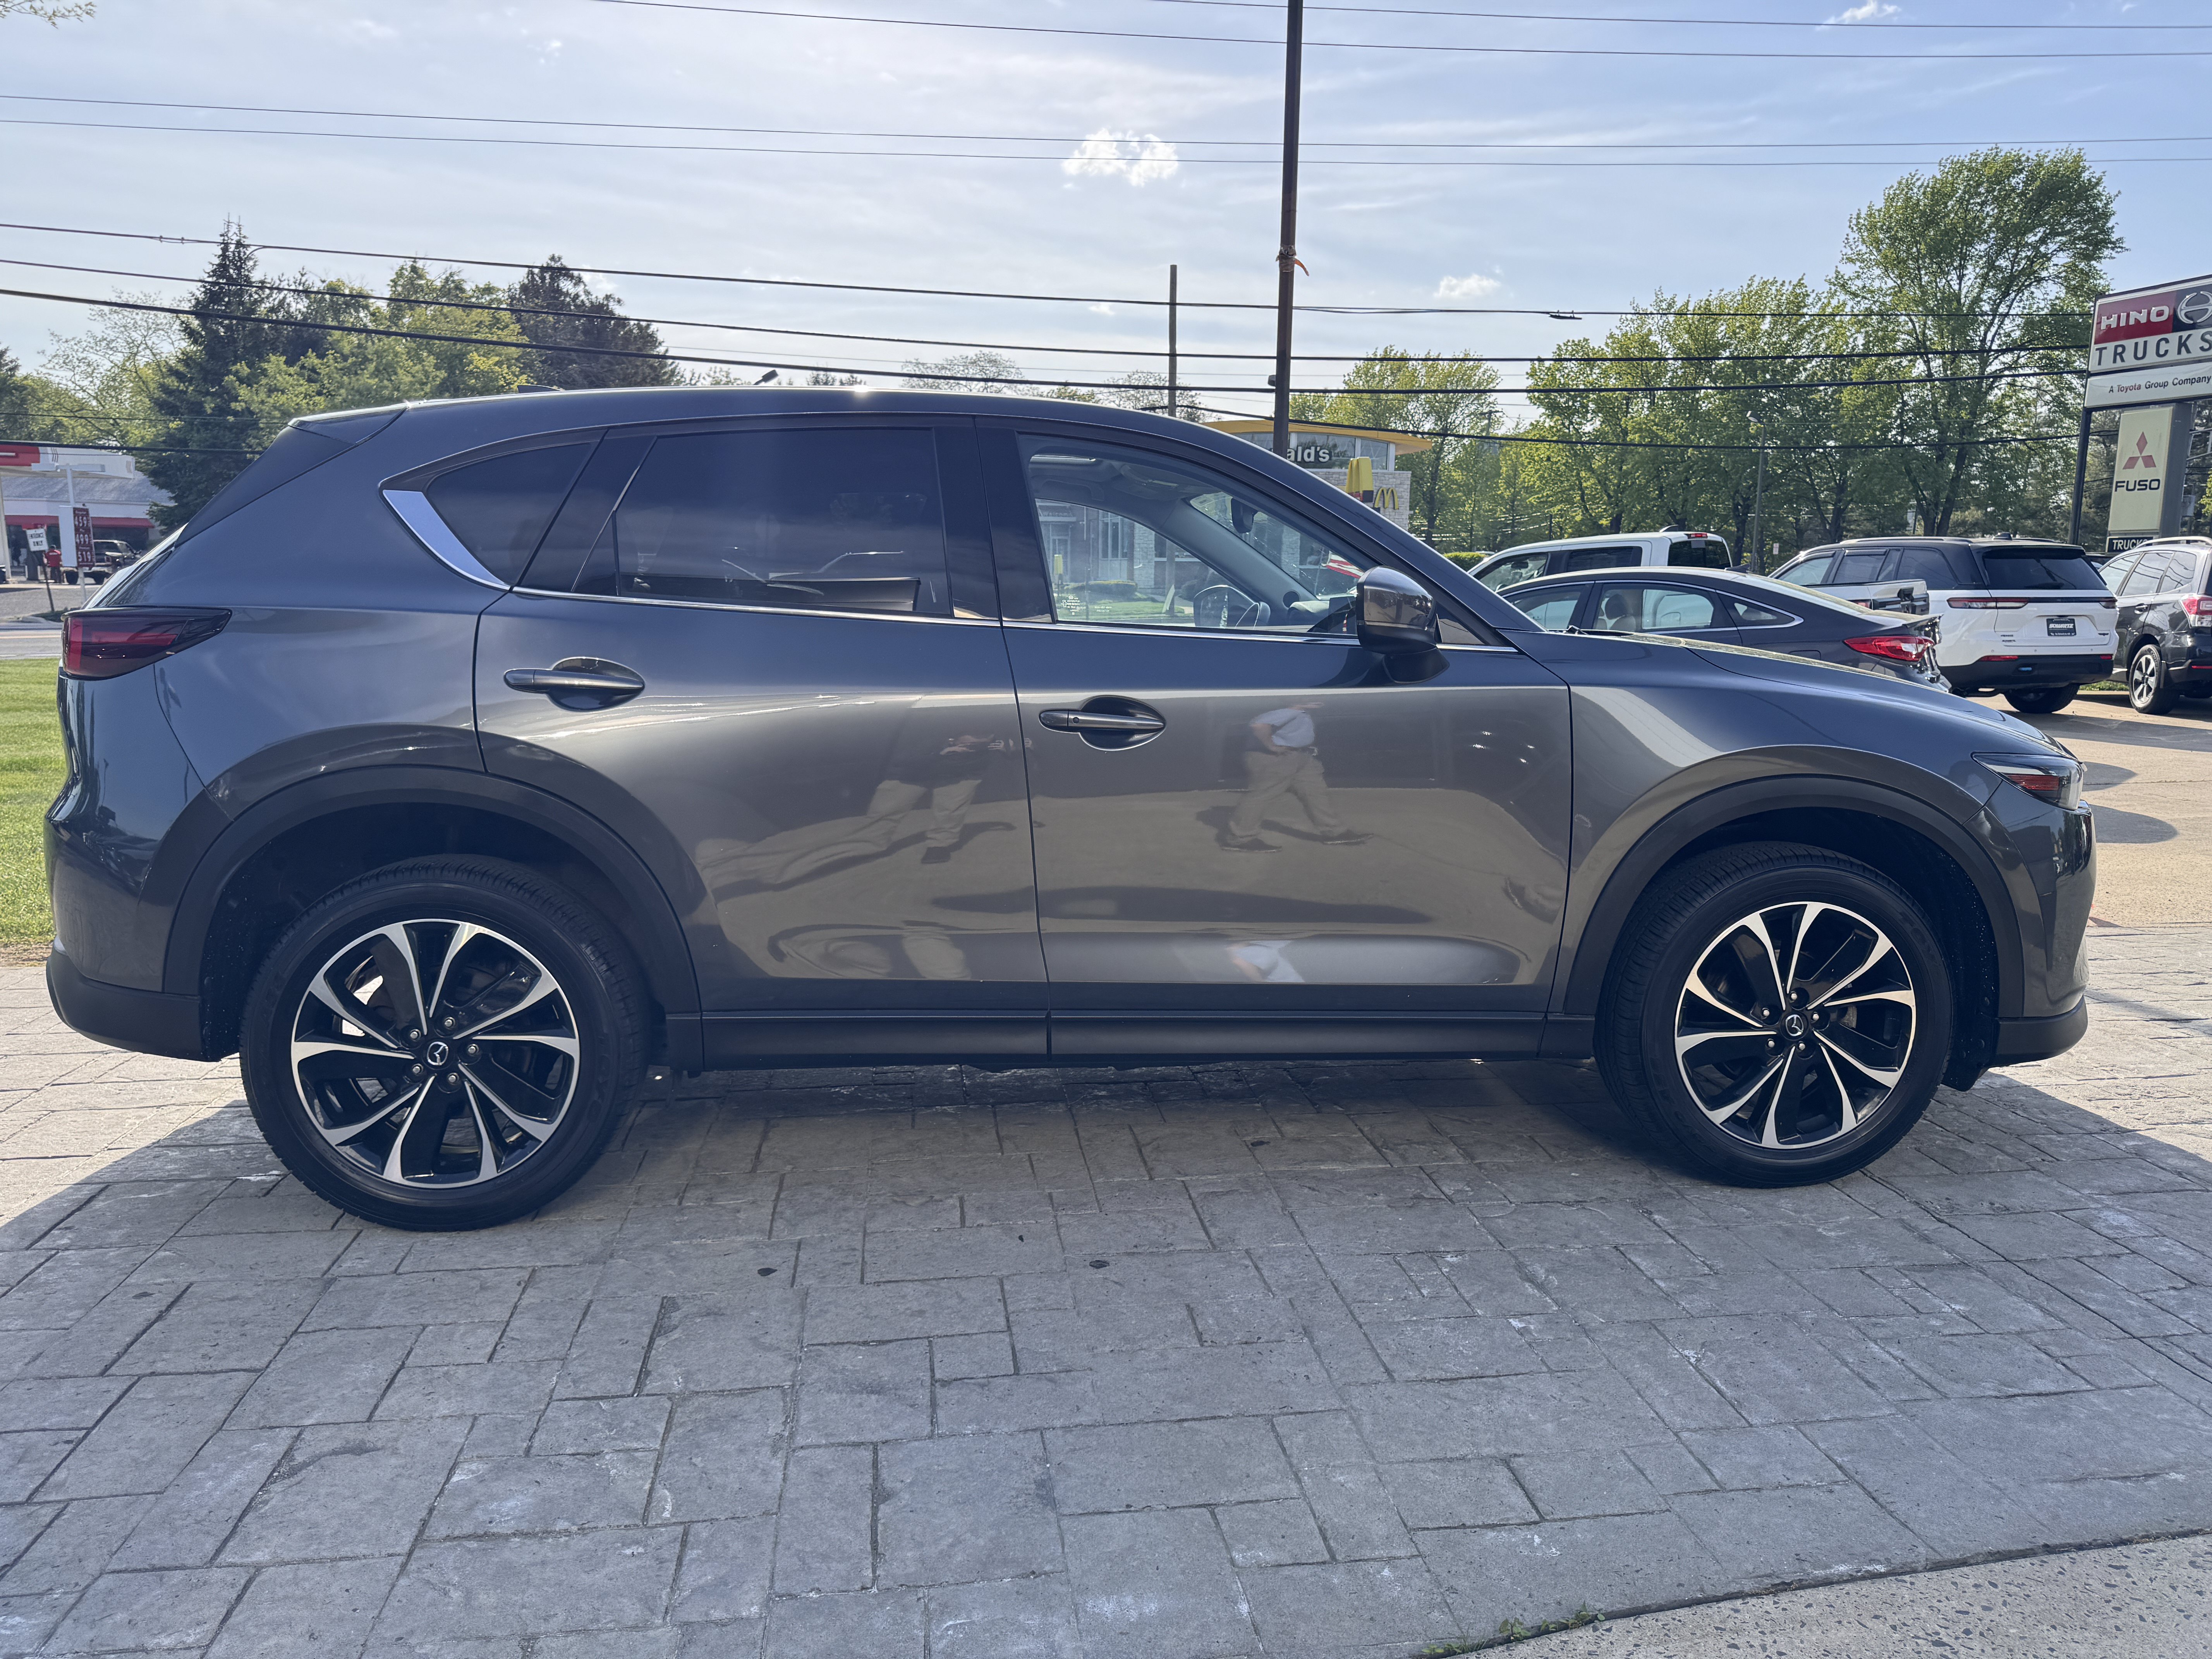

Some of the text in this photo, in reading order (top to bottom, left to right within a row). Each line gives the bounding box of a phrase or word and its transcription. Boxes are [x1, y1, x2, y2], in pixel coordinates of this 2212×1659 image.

[2100, 306, 2169, 330] HINO
[2095, 330, 2212, 366] TRUCKS
[2109, 375, 2212, 393] A Toyota Group Company
[1287, 446, 1329, 462] ald's
[2114, 479, 2160, 492] FUSO
